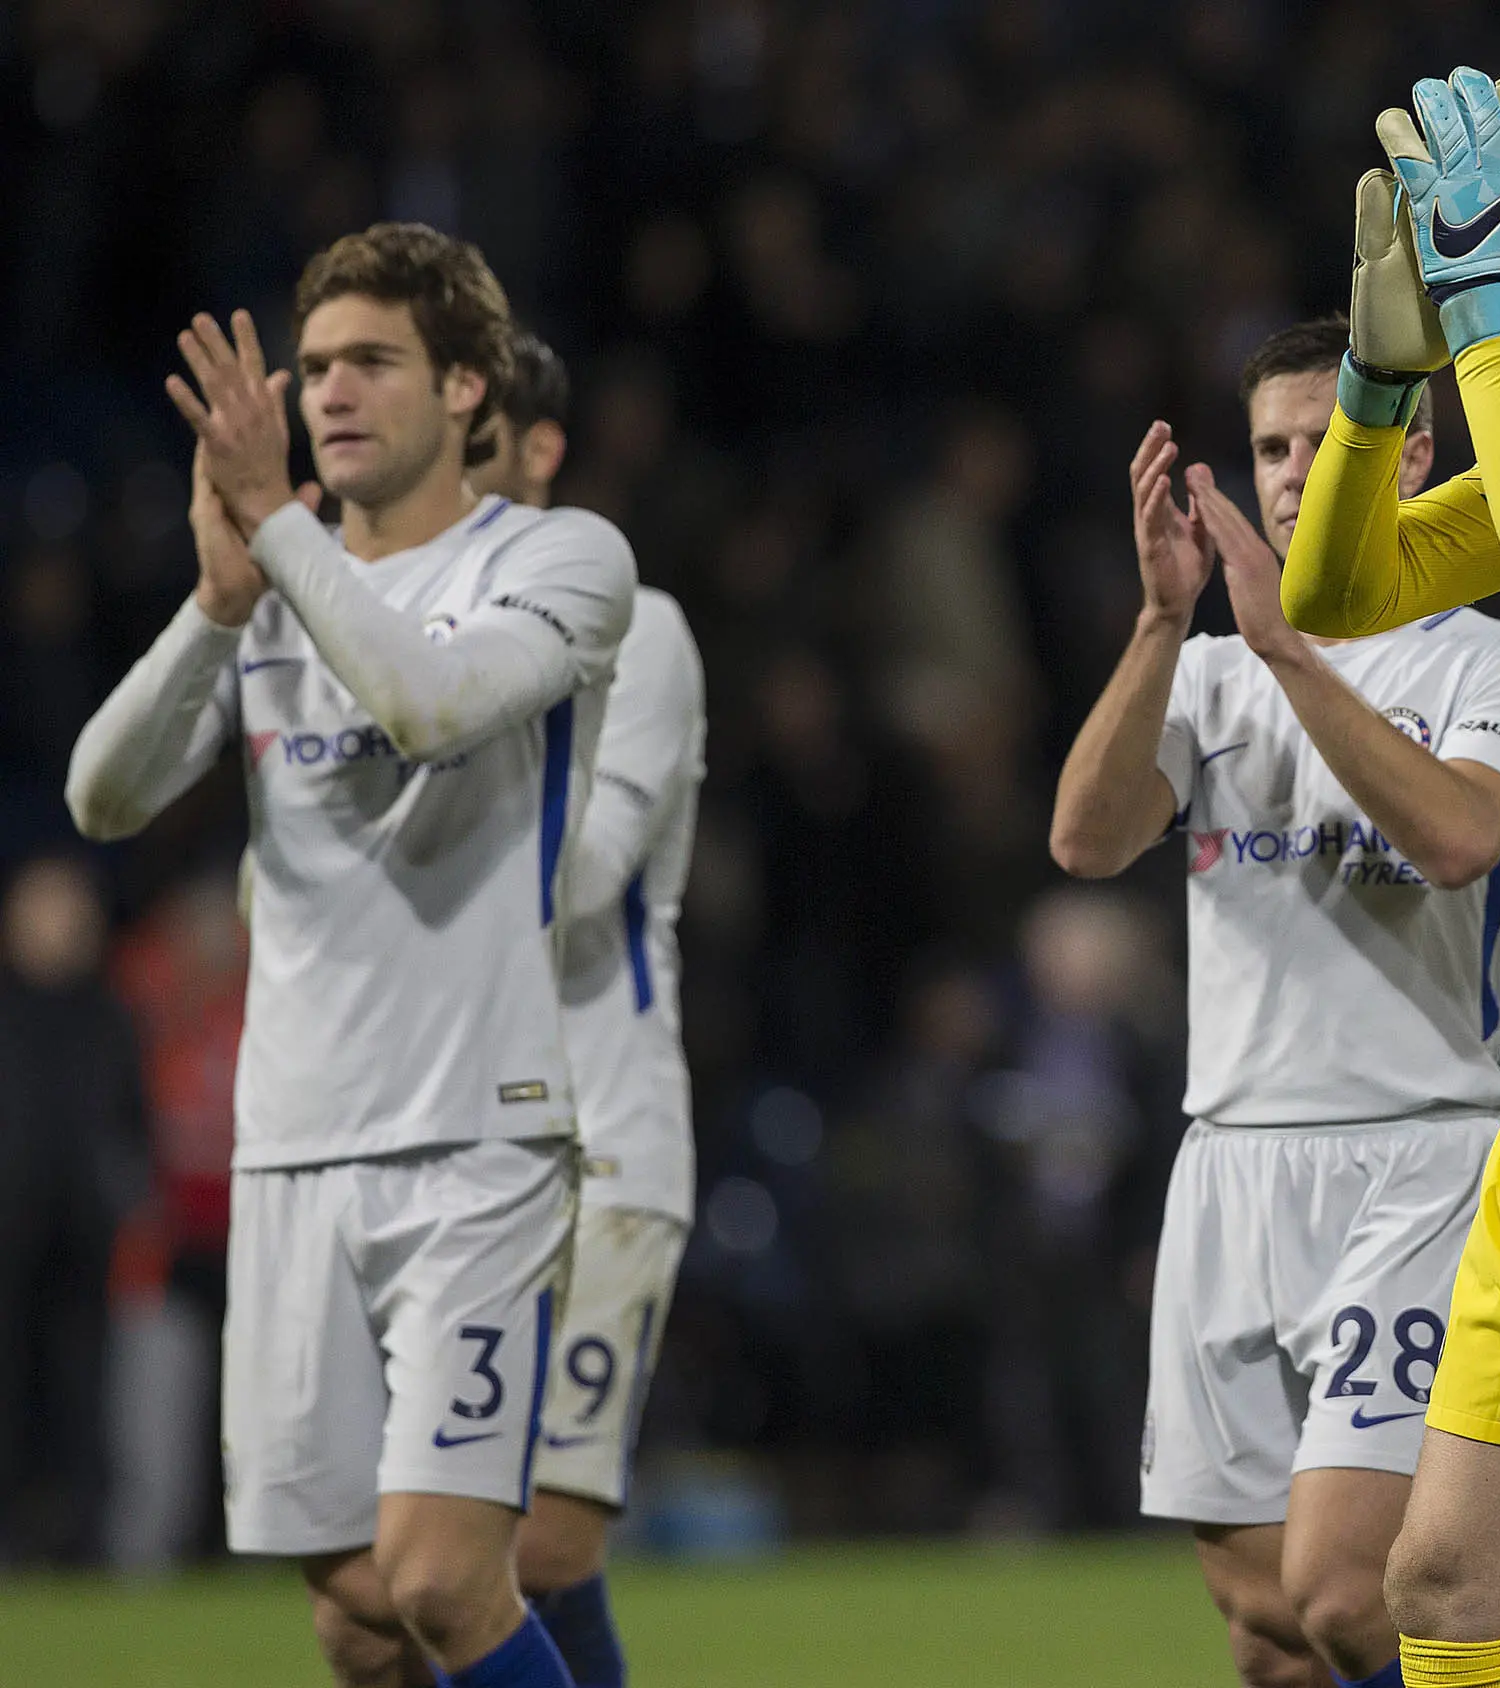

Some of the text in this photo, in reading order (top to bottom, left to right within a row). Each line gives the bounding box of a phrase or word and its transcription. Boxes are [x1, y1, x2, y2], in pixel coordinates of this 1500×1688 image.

[449, 1325, 505, 1420] 3
[566, 1335, 616, 1425] 9
[1324, 1305, 1446, 1404] 28
